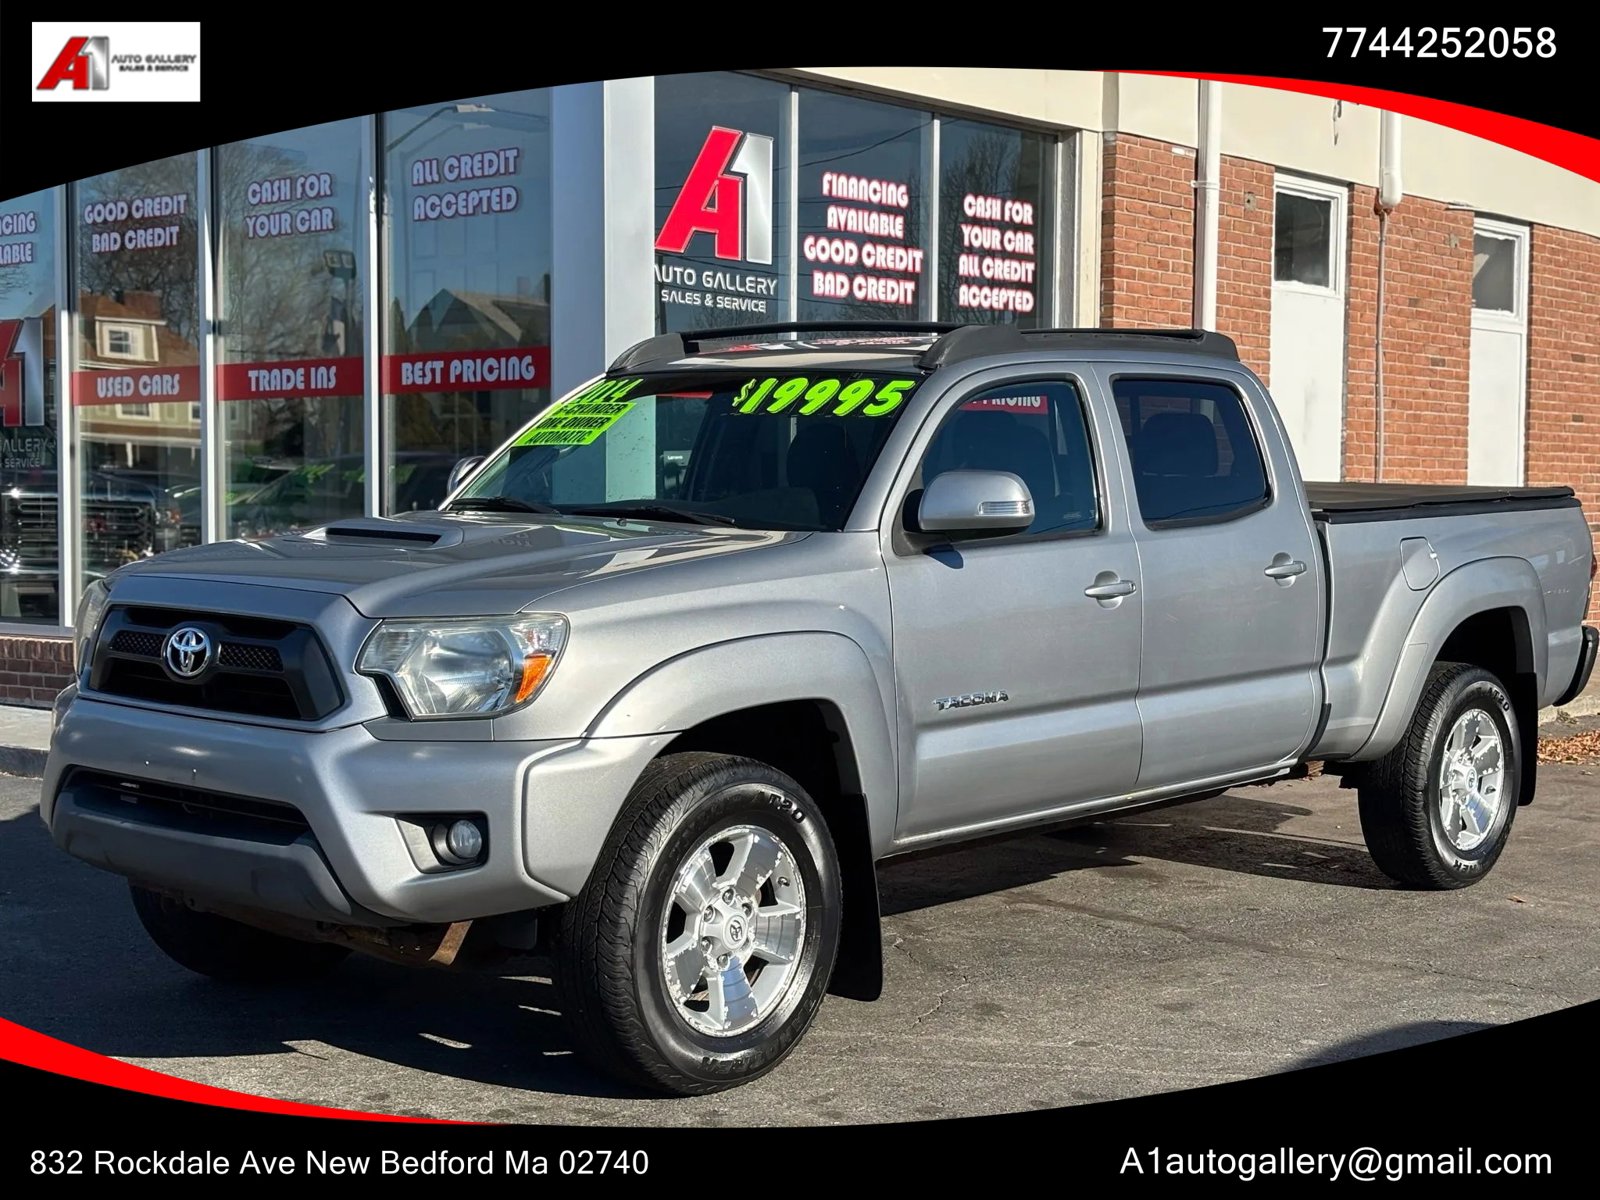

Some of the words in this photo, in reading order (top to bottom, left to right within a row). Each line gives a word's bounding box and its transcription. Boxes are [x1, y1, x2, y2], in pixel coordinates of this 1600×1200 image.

[411, 159, 441, 186] ALL
[442, 147, 520, 182] CREDIT
[246, 178, 292, 206] CASH
[295, 172, 332, 200] FOR
[412, 184, 519, 222] ACCEPTED
[654, 125, 774, 265] A1
[821, 171, 909, 209] FINANCING
[0, 211, 37, 237] CING
[83, 201, 129, 225] GOOD
[130, 193, 188, 220] CREDIT
[244, 211, 293, 239] YOUR
[295, 206, 335, 234] CAR
[826, 204, 905, 240] AVAILABLE
[963, 193, 1001, 221] CASH
[1003, 200, 1034, 226] FOR
[91, 232, 122, 253] BAD
[123, 225, 180, 250] CREDIT
[802, 234, 860, 266] GOOD
[861, 242, 924, 274] CREDIT
[960, 223, 1002, 251] YOUR
[1003, 230, 1035, 255] CAR
[702, 271, 778, 296] GALLERY
[958, 253, 981, 279] ALL
[981, 256, 1036, 285] CREDIT
[661, 289, 701, 306] SALES
[704, 293, 714, 308] &
[716, 296, 767, 314] SERVICE
[812, 269, 850, 299] BAD
[852, 273, 916, 305] CREDIT
[958, 283, 1036, 314] ACCEPTED
[96, 377, 134, 399] USED
[138, 373, 181, 397] CARS
[247, 367, 306, 393] TRADE
[310, 365, 338, 391] INS
[401, 360, 445, 386] BEST
[449, 354, 536, 384] PRICING
[732, 377, 916, 417] $19995
[525, 430, 593, 444] AUTOMATIC
[932, 689, 1009, 711] TACOMA
